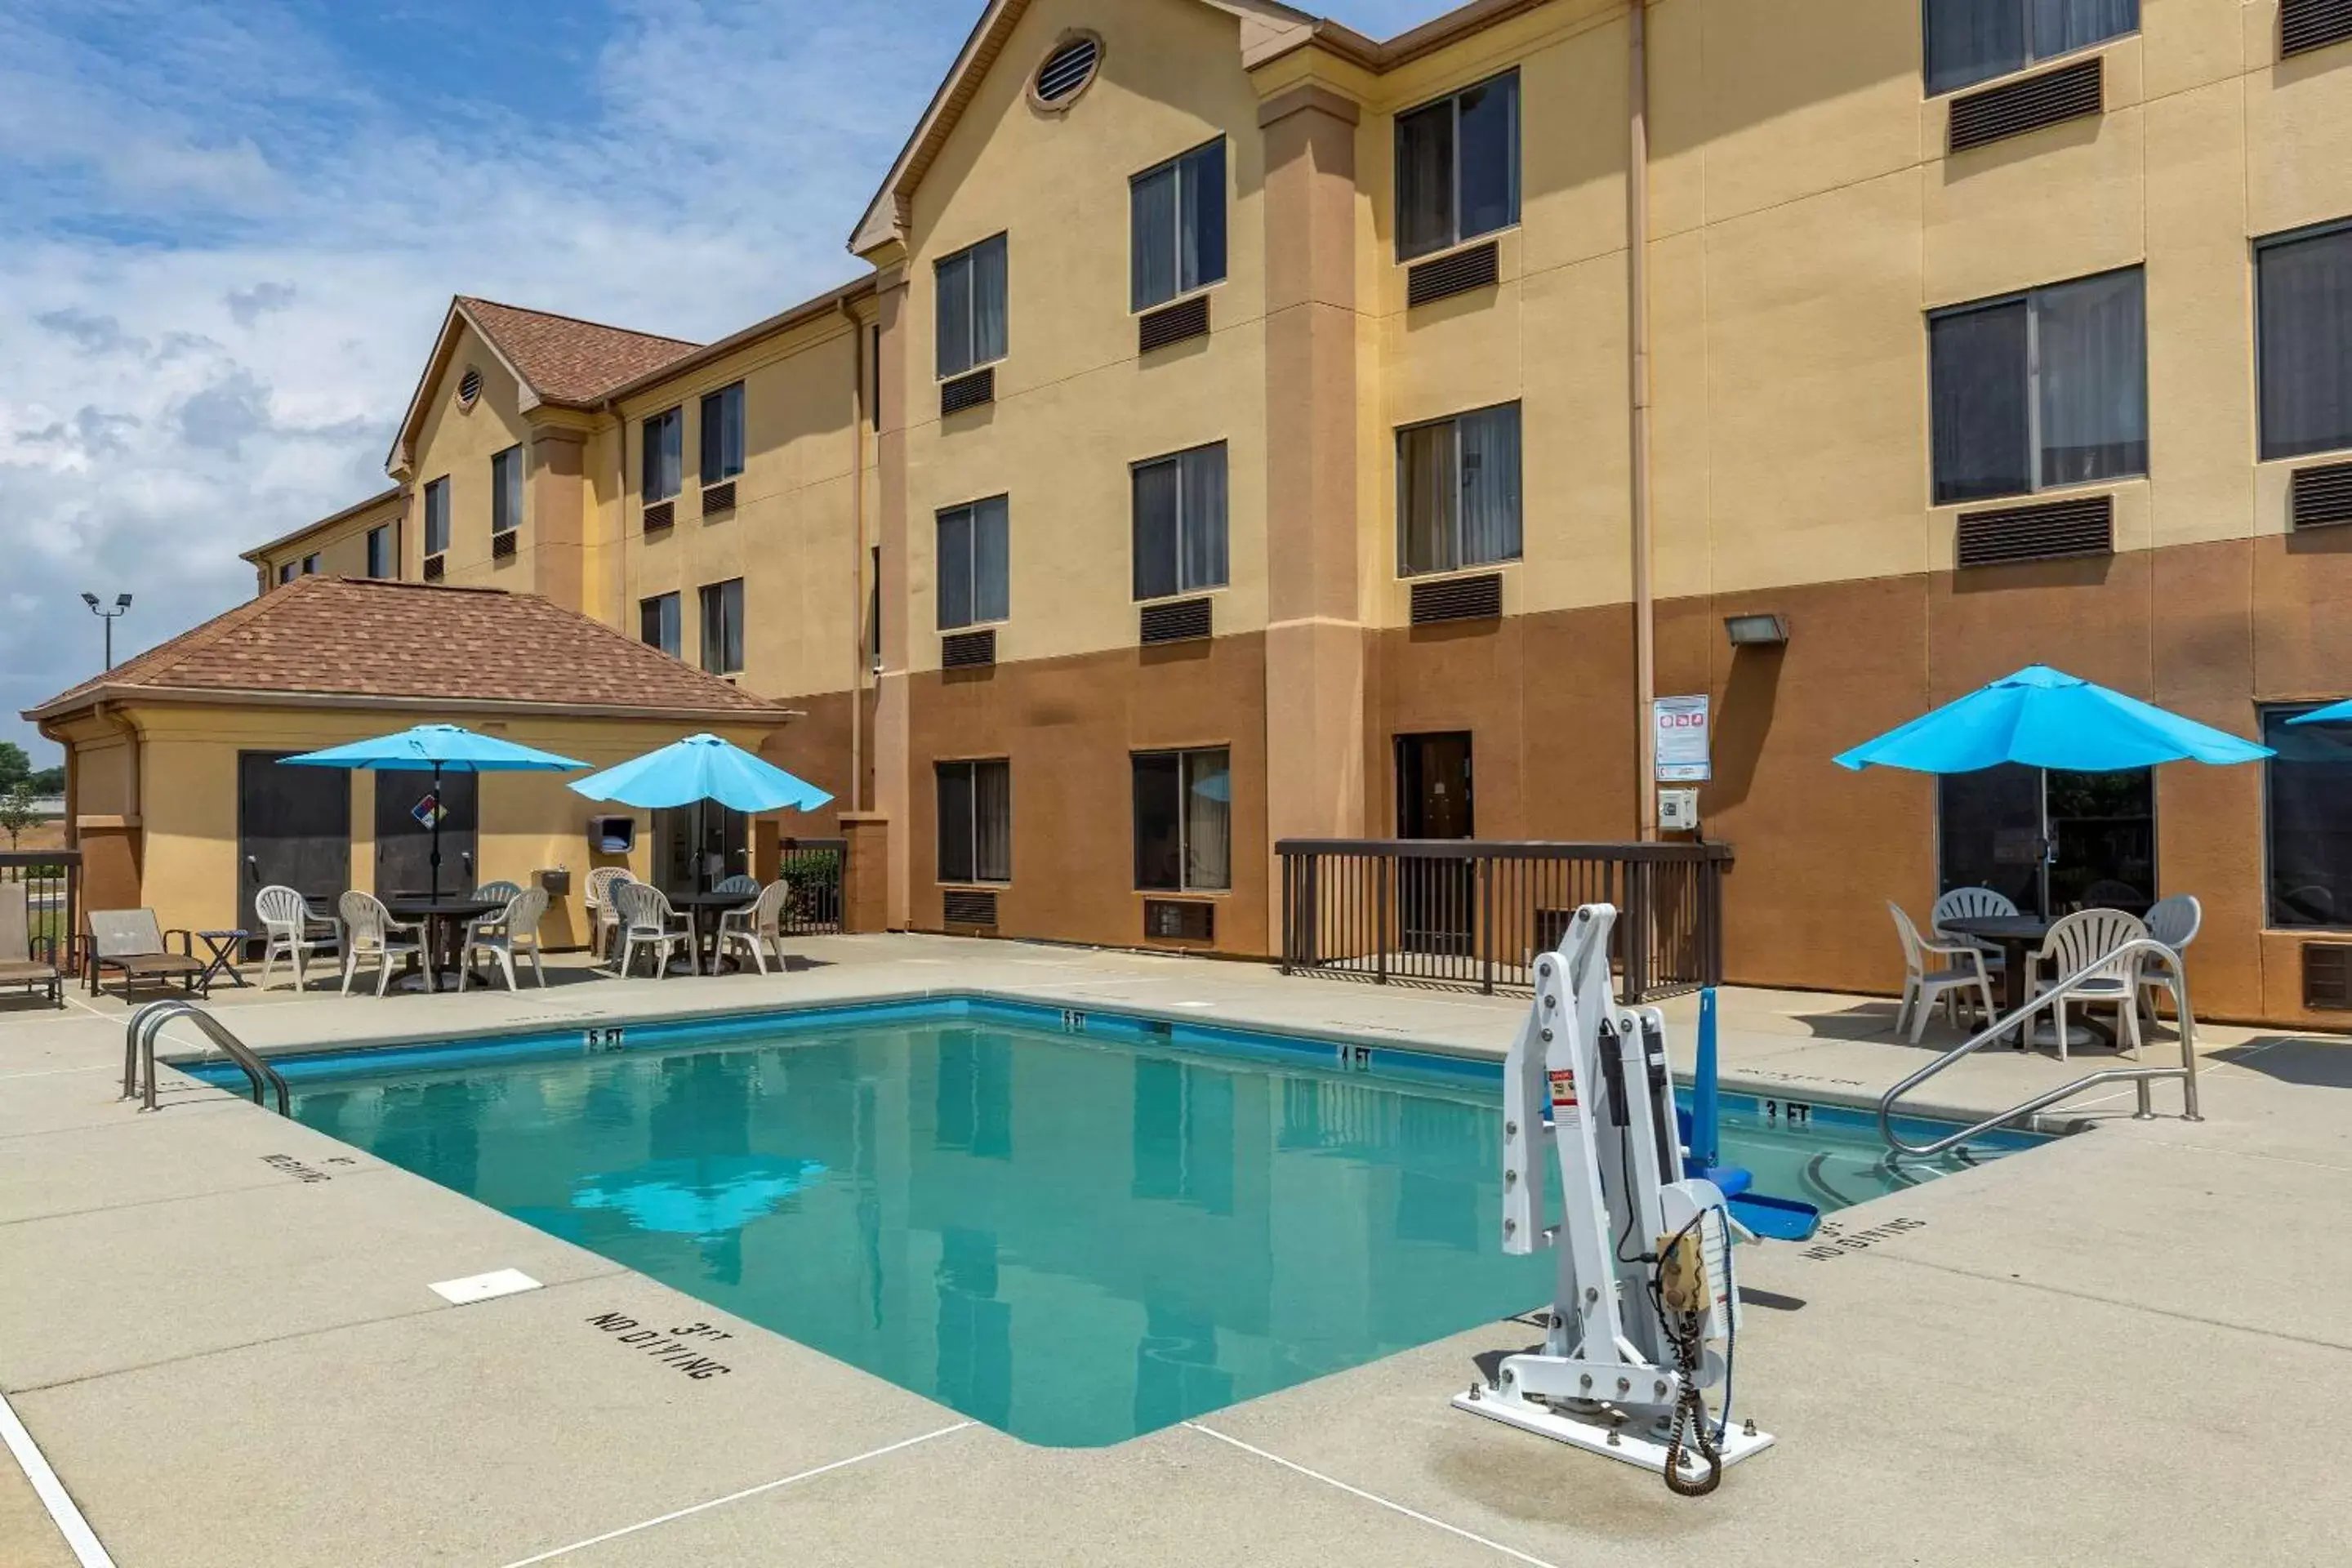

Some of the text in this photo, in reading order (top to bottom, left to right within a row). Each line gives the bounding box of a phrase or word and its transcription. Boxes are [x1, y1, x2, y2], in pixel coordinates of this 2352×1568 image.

[605, 1028, 623, 1043] FT
[1356, 1047, 1371, 1062] FT
[1787, 1102, 1811, 1121] FT
[1798, 1217, 1927, 1262] NO DIVING
[585, 1311, 732, 1380] NO DIVING
